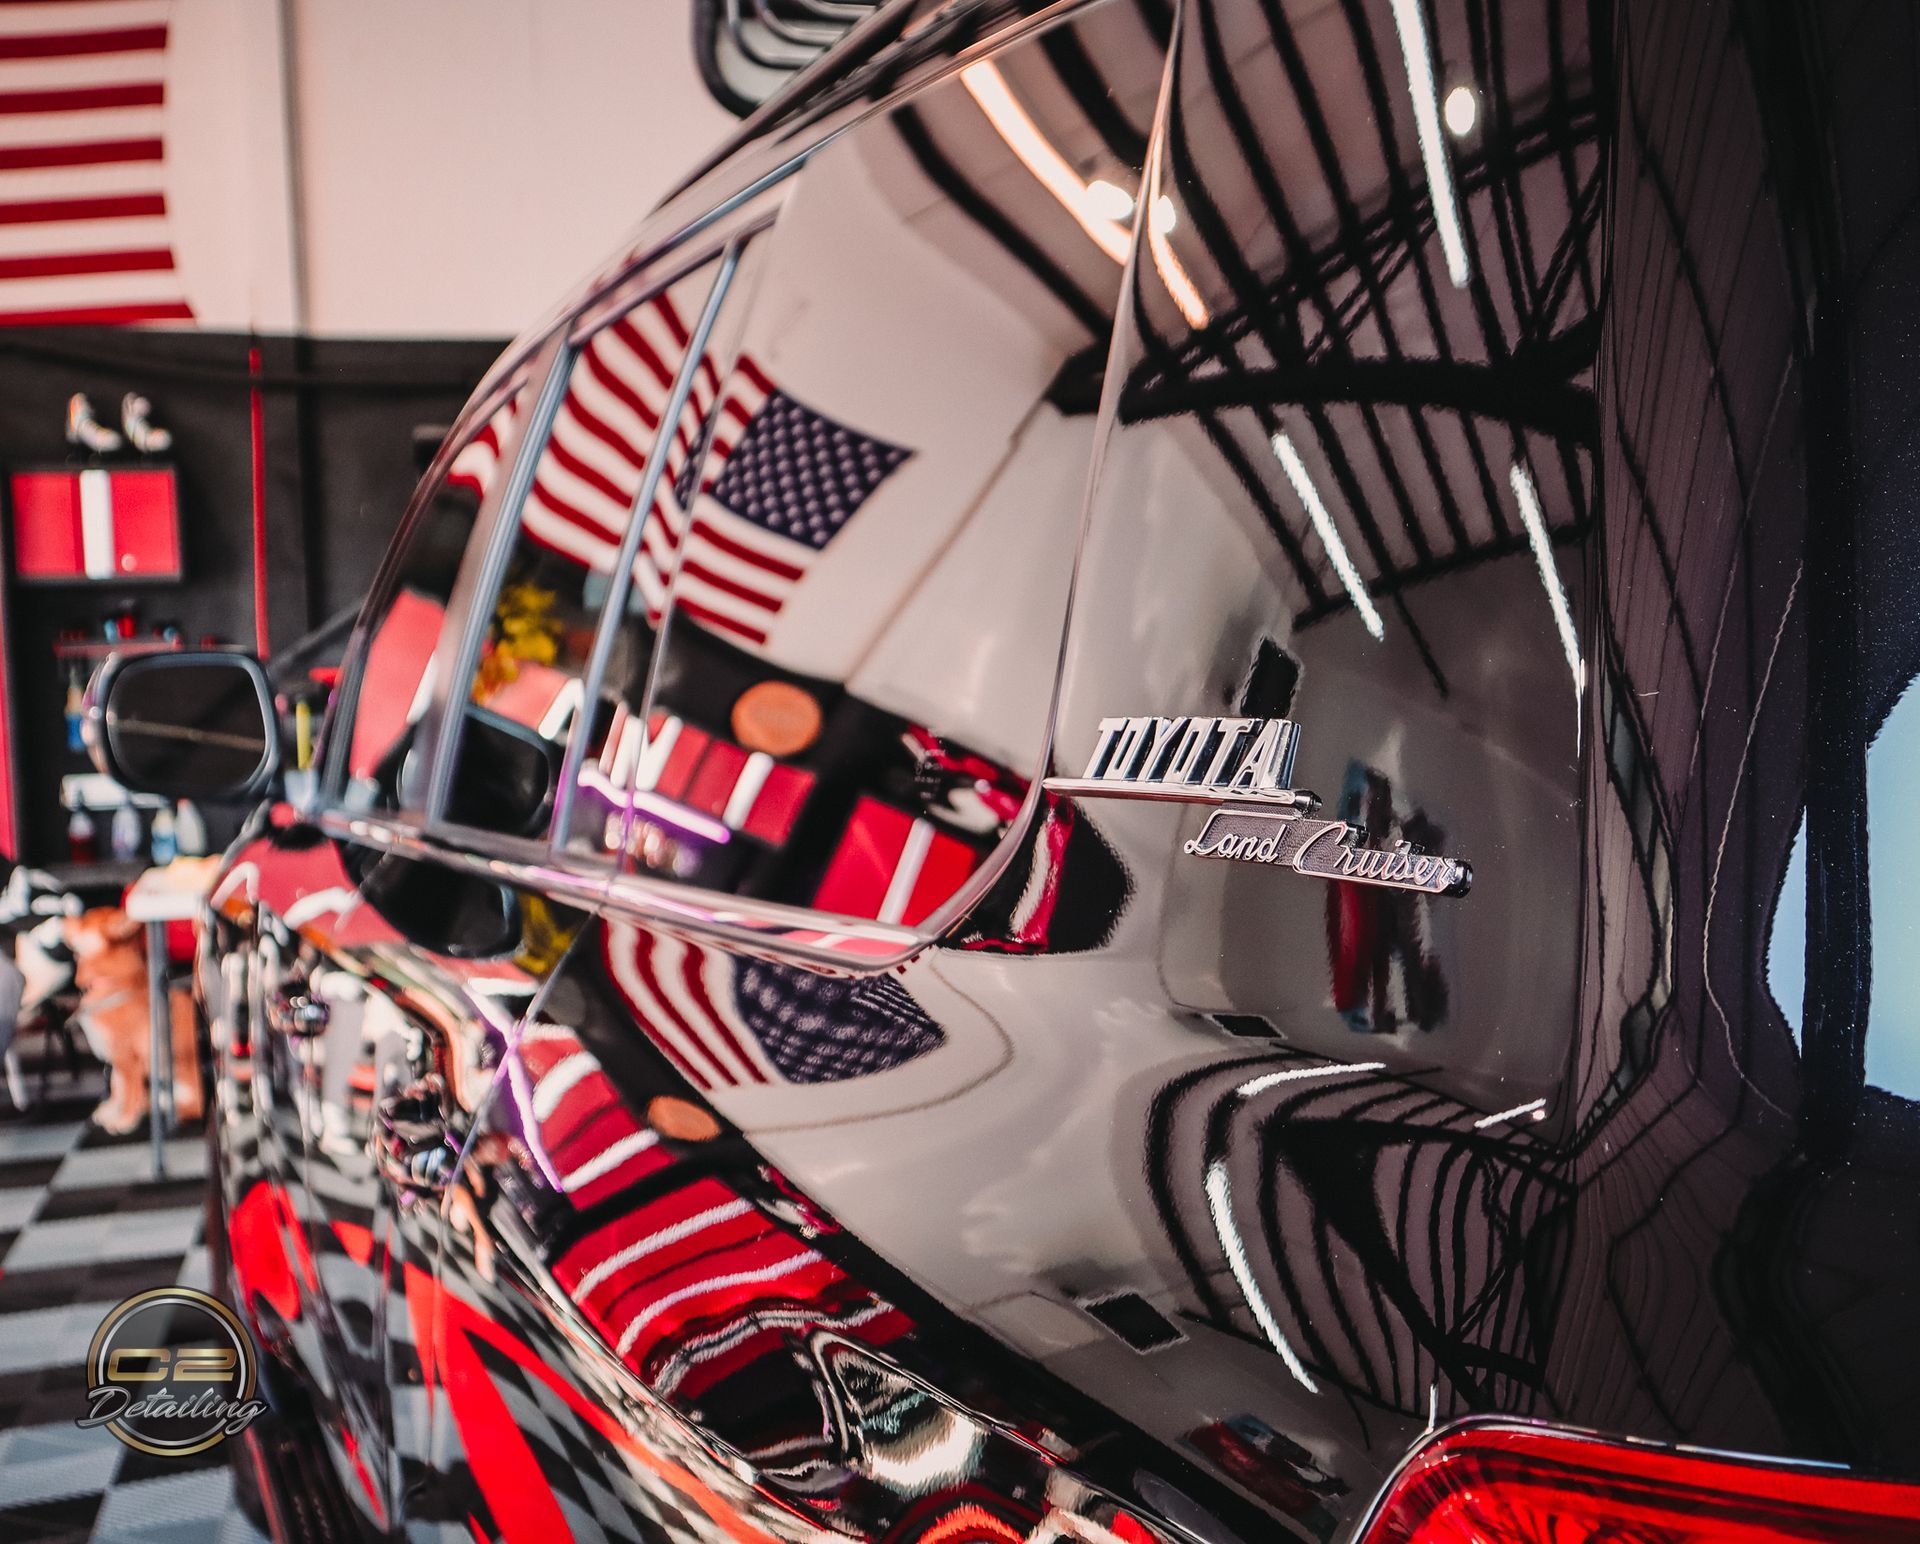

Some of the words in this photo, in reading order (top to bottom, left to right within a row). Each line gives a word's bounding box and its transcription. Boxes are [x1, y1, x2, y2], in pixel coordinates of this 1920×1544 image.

[1082, 717, 1293, 789] TOYOTA
[1184, 810, 1288, 863] Land
[1292, 821, 1457, 888] Cruiser
